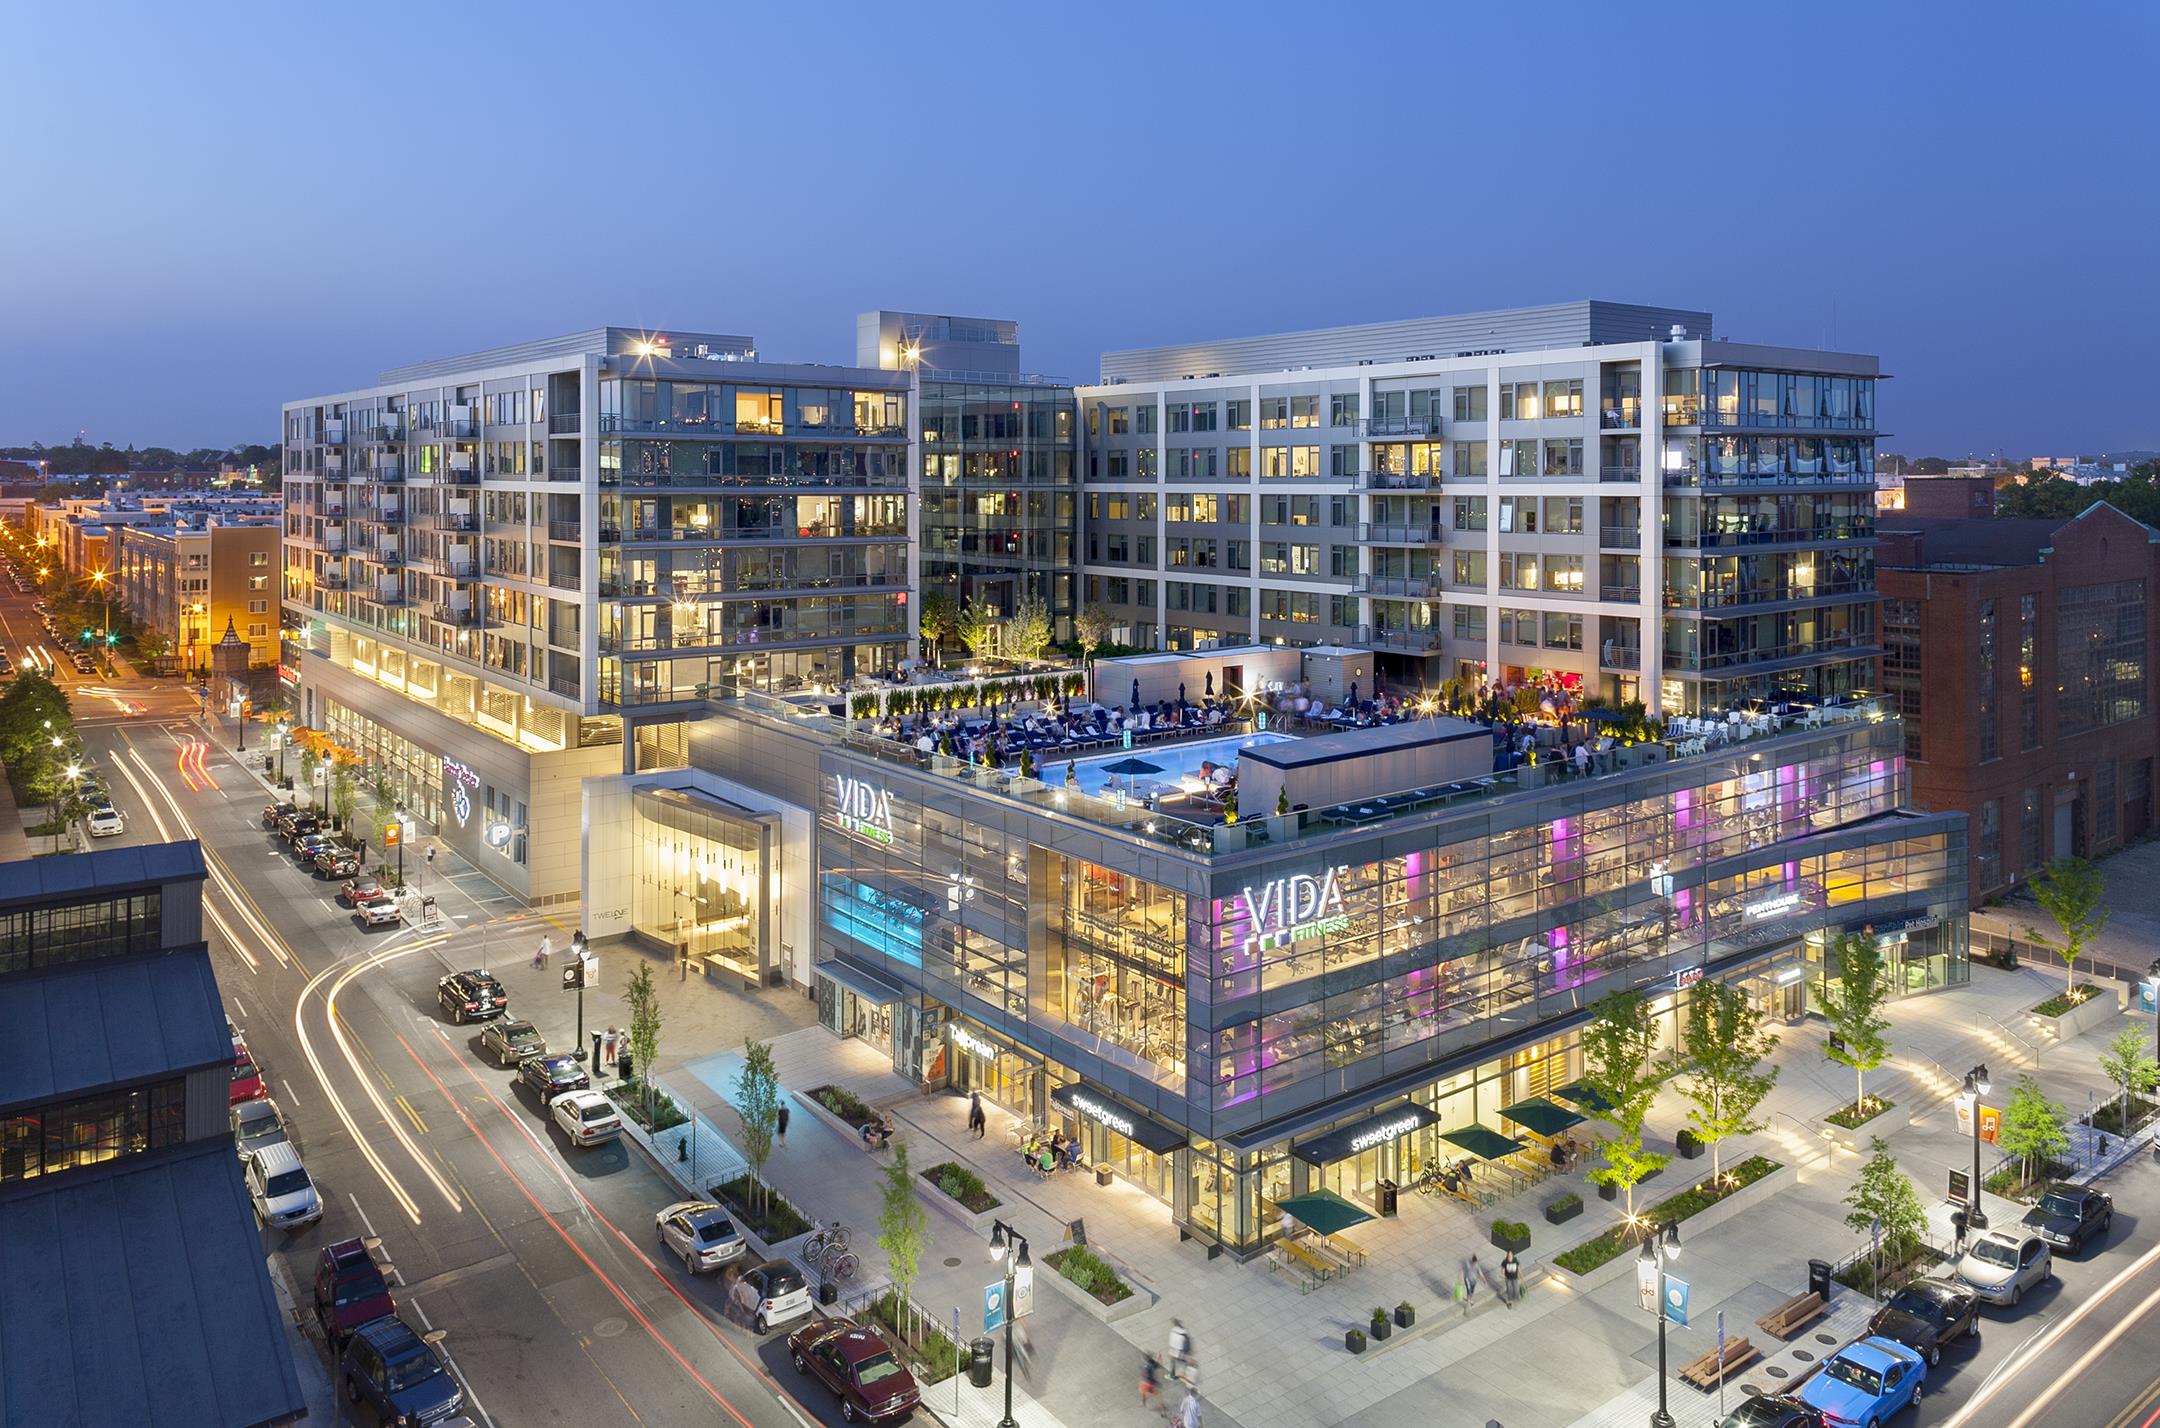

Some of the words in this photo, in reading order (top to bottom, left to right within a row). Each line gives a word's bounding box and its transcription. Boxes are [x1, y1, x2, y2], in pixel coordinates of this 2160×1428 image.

[836, 773, 893, 830] VIDA
[492, 824, 511, 845] P
[1243, 867, 1345, 934] VIDA
[1746, 893, 1800, 917] PENTHOUSE
[1291, 913, 1350, 943] FITNESS
[1072, 1094, 1133, 1137] sweetgreen
[1351, 1115, 1419, 1152] sweetgreen
